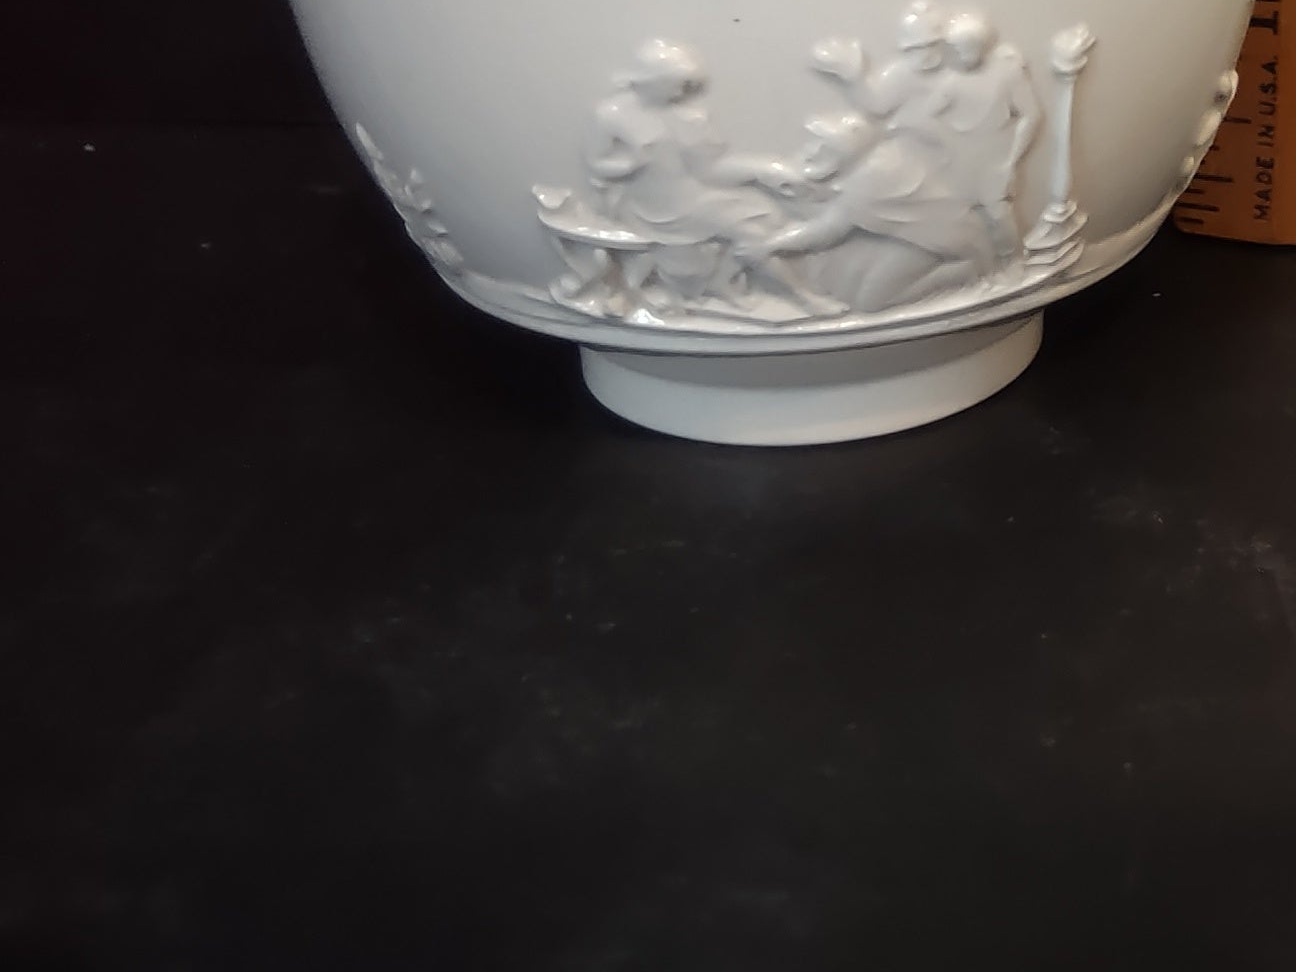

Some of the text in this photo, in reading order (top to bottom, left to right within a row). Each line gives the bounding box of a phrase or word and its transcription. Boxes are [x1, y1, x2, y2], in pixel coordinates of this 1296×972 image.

[1253, 55, 1278, 221] MADE IN U.S.A.
